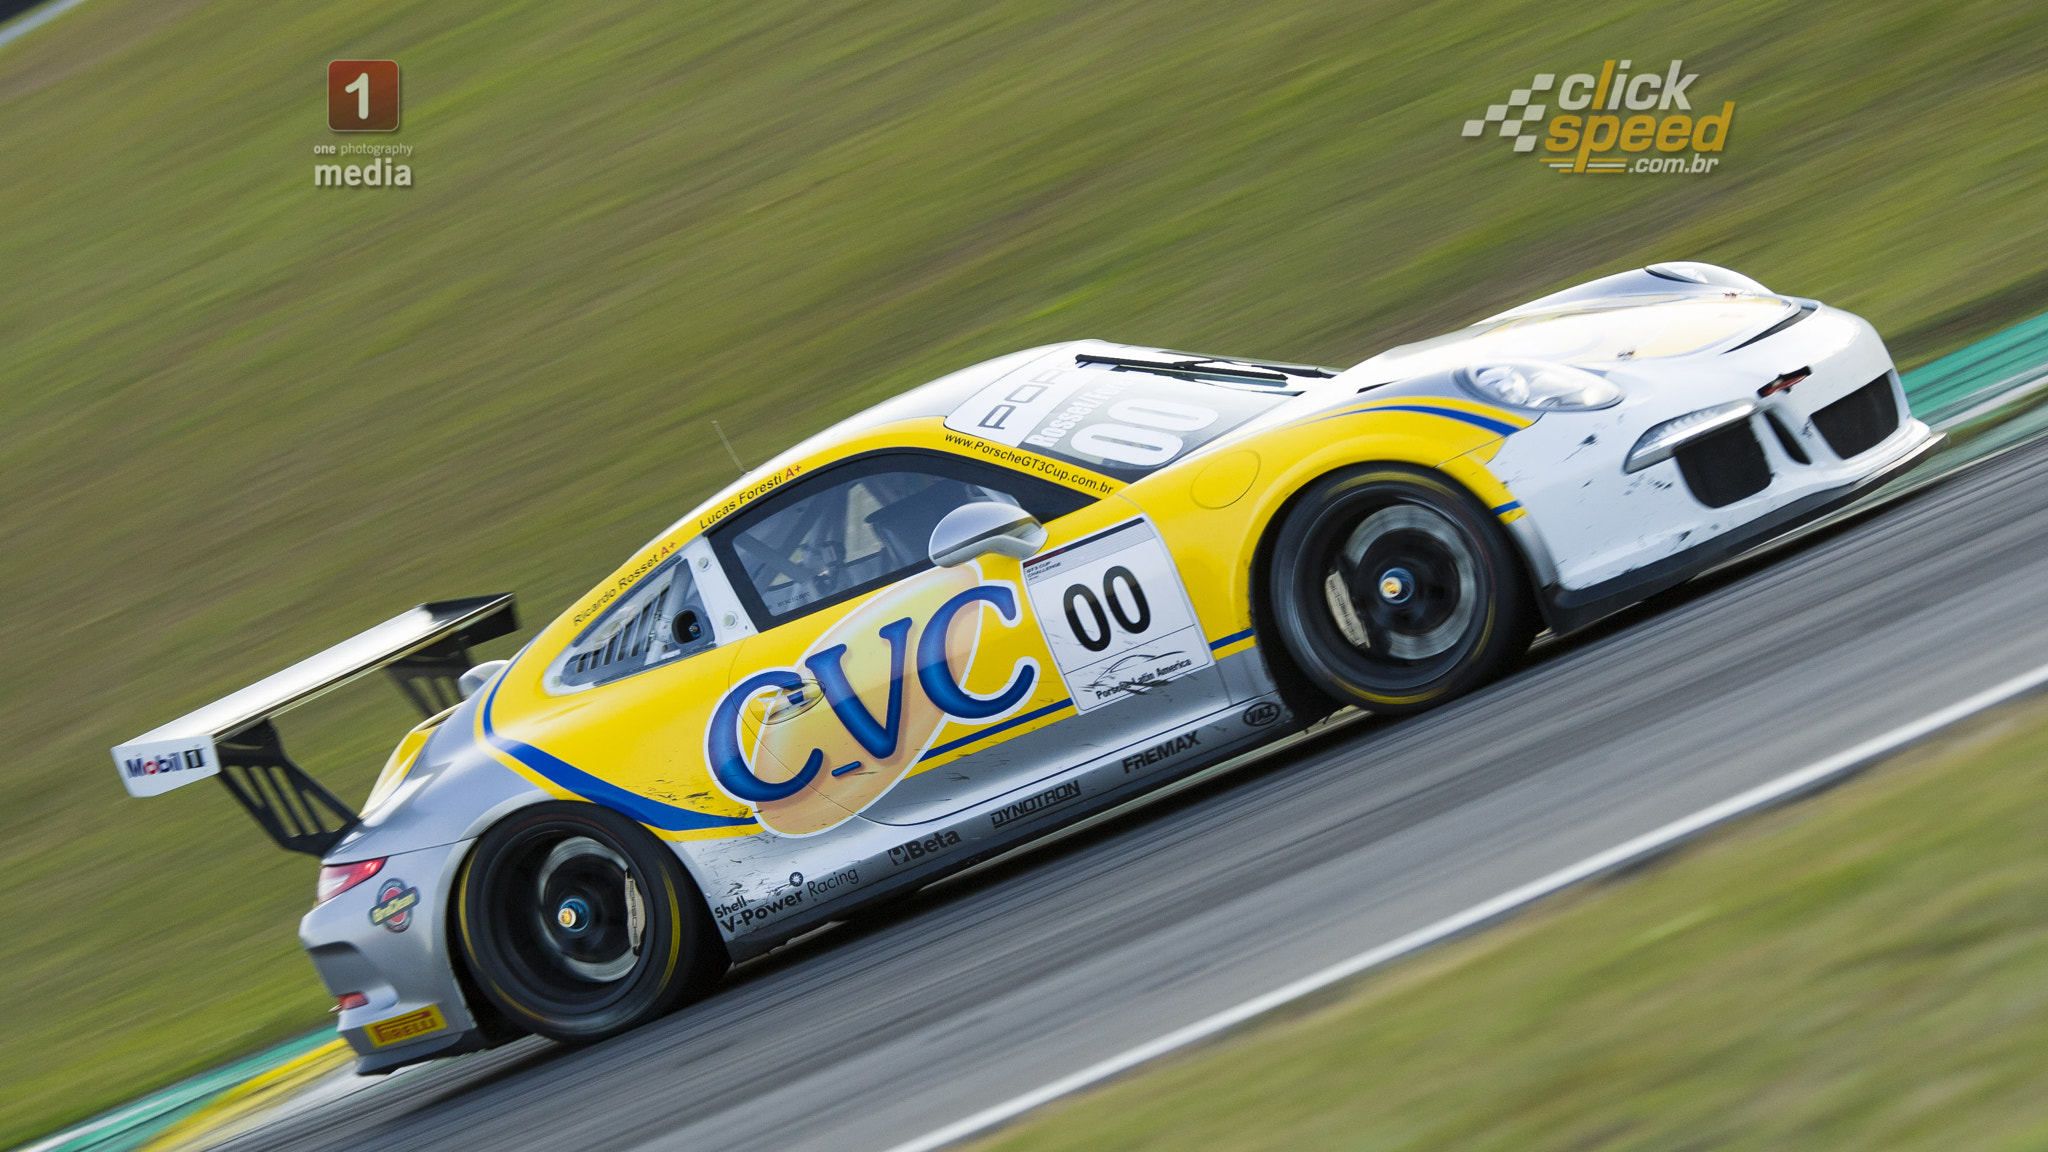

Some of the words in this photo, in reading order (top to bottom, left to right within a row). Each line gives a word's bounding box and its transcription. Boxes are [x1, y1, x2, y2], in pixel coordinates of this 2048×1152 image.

[1071, 399, 1219, 466] 00
[945, 432, 1114, 496] www.PorscheGT3Cup.com.br
[699, 500, 736, 530] Lucas
[739, 474, 783, 504] Foresti
[785, 464, 802, 481] A+
[573, 588, 617, 627] Ricardo
[618, 553, 659, 588] Rosset
[660, 541, 676, 558] A+
[1063, 565, 1151, 652] 00
[1156, 658, 1192, 678] America
[126, 751, 183, 778] Mobil
[1122, 730, 1201, 773] FREMAX
[990, 780, 1081, 828] DYNOTRON
[909, 829, 961, 860] Beta
[714, 895, 747, 919] Shell
[720, 891, 802, 933] V-Power
[807, 866, 859, 900] Racing
[374, 1010, 437, 1042] PIRELLI
